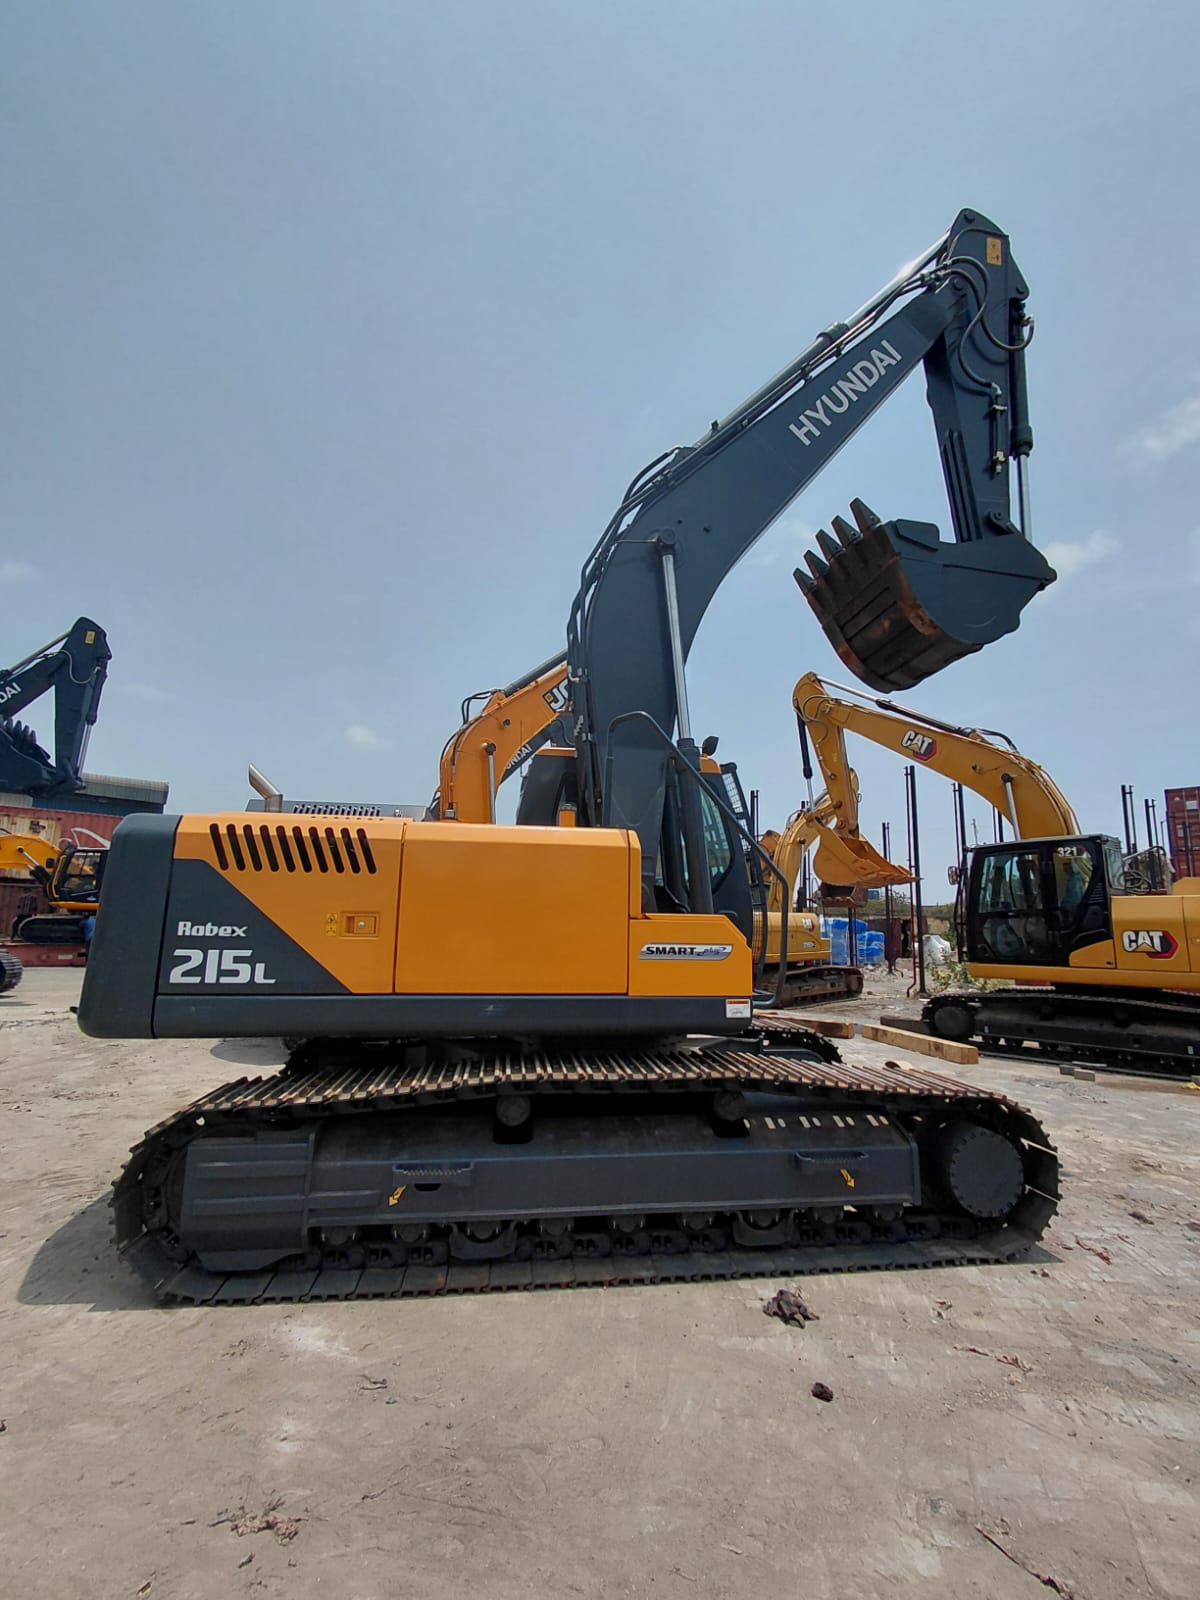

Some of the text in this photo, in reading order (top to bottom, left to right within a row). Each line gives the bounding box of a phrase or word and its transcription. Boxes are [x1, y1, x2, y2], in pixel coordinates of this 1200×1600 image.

[788, 339, 902, 446] HYUNDAI
[902, 730, 933, 754] CAT
[1057, 846, 1077, 857] 321
[177, 921, 248, 937] Robex
[646, 946, 696, 955] SMART
[1122, 930, 1163, 952] CAT
[169, 949, 276, 983] 215L
